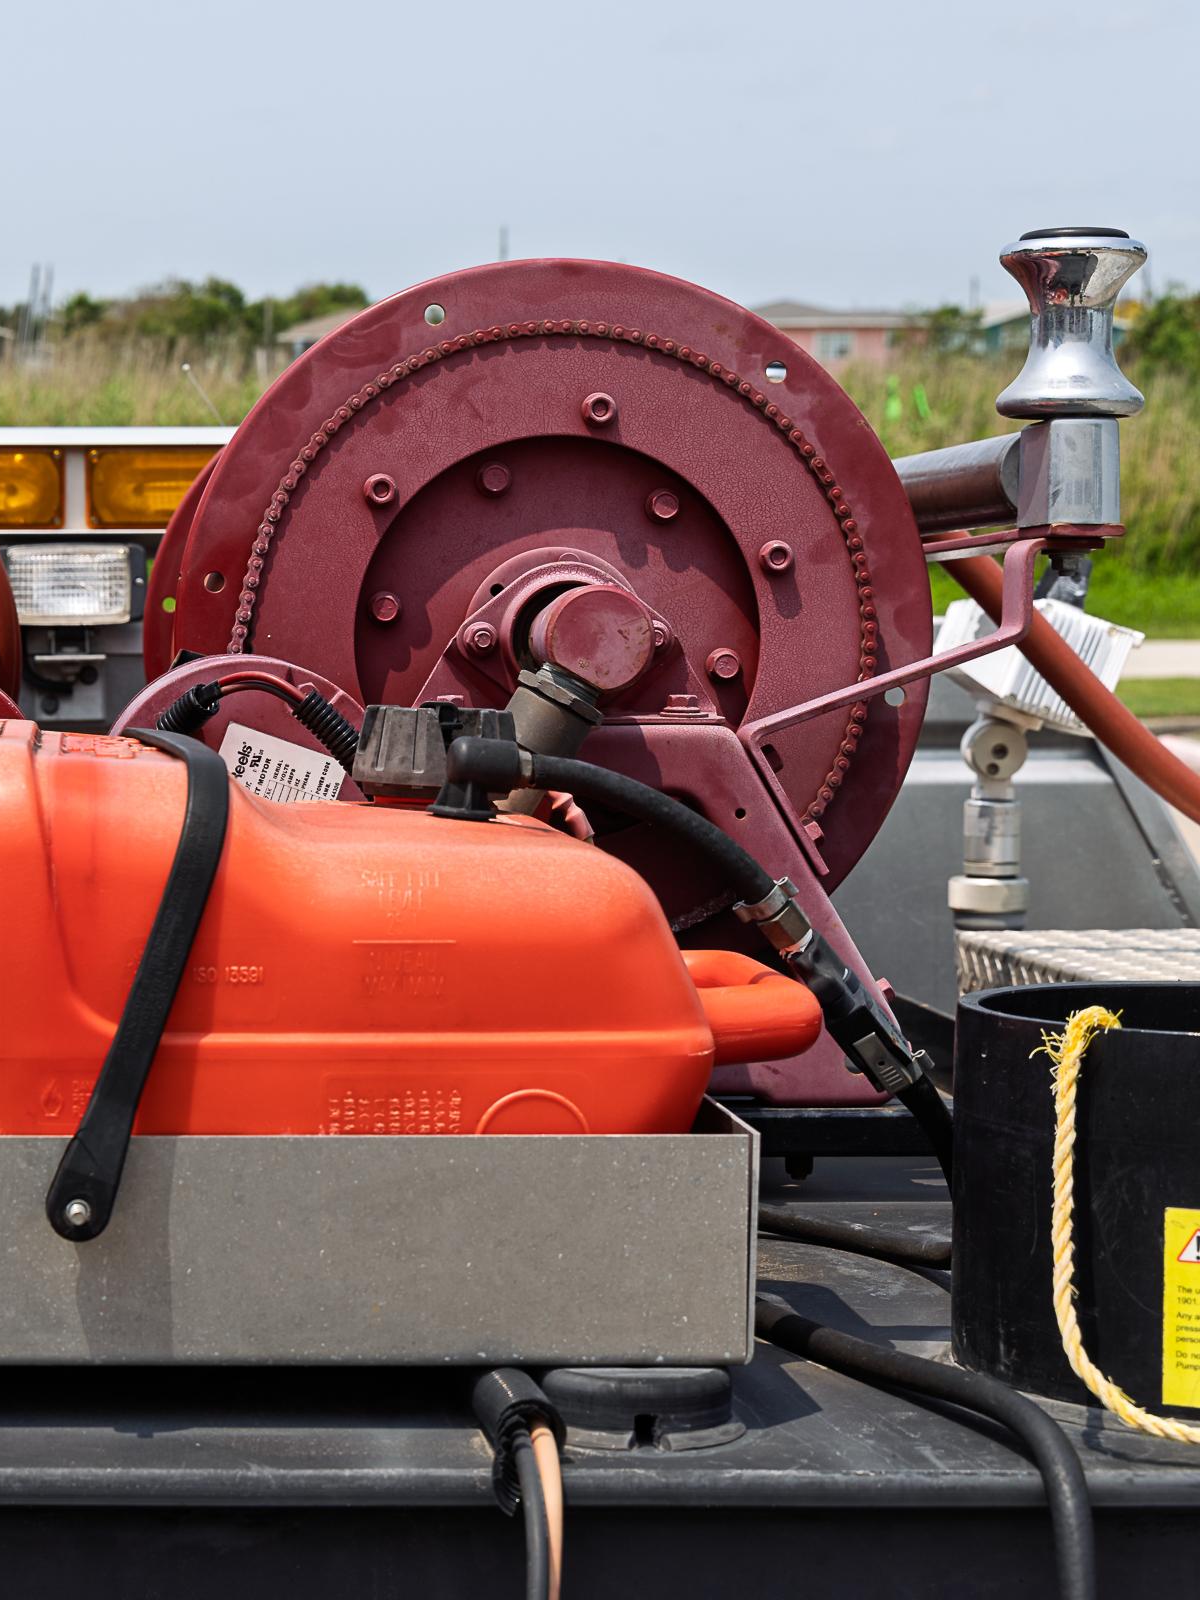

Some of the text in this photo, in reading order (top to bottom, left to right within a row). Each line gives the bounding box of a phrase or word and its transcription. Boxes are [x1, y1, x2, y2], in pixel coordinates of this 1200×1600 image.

[258, 757, 272, 786] MOTOR
[192, 965, 217, 984] ISO
[1177, 1285, 1193, 1294] The
[1176, 1312, 1192, 1321] Any
[1175, 1350, 1188, 1359] Do
